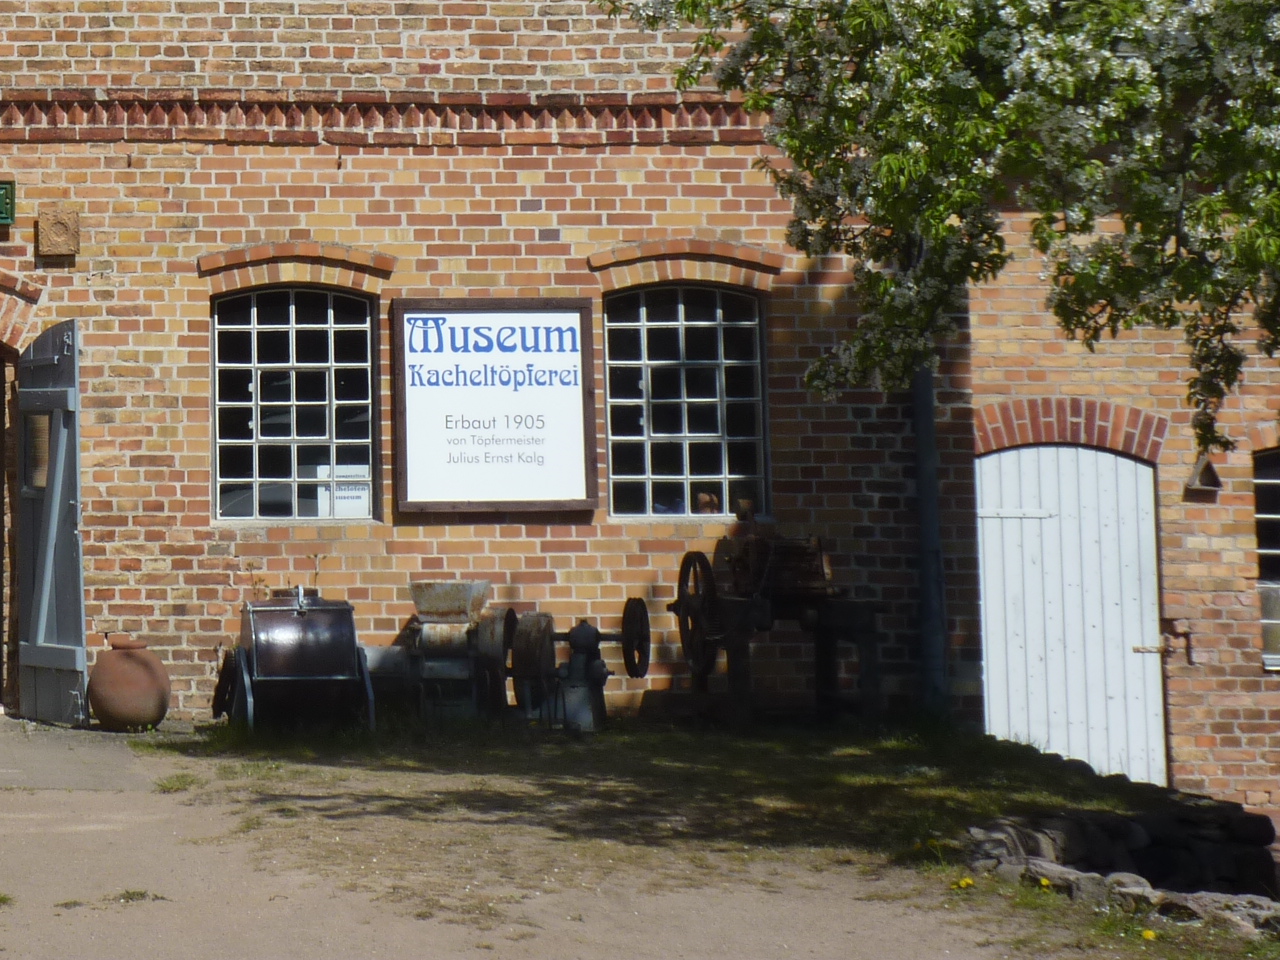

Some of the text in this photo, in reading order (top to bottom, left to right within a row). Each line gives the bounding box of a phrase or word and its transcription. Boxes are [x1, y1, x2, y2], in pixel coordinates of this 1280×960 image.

[406, 317, 580, 353] Museum
[408, 363, 579, 391] Kacheltöpferei
[445, 414, 545, 429] Erbaut 1905
[446, 434, 545, 447] von Töpfermeister
[446, 451, 545, 466] Julius Ernst Kalg
